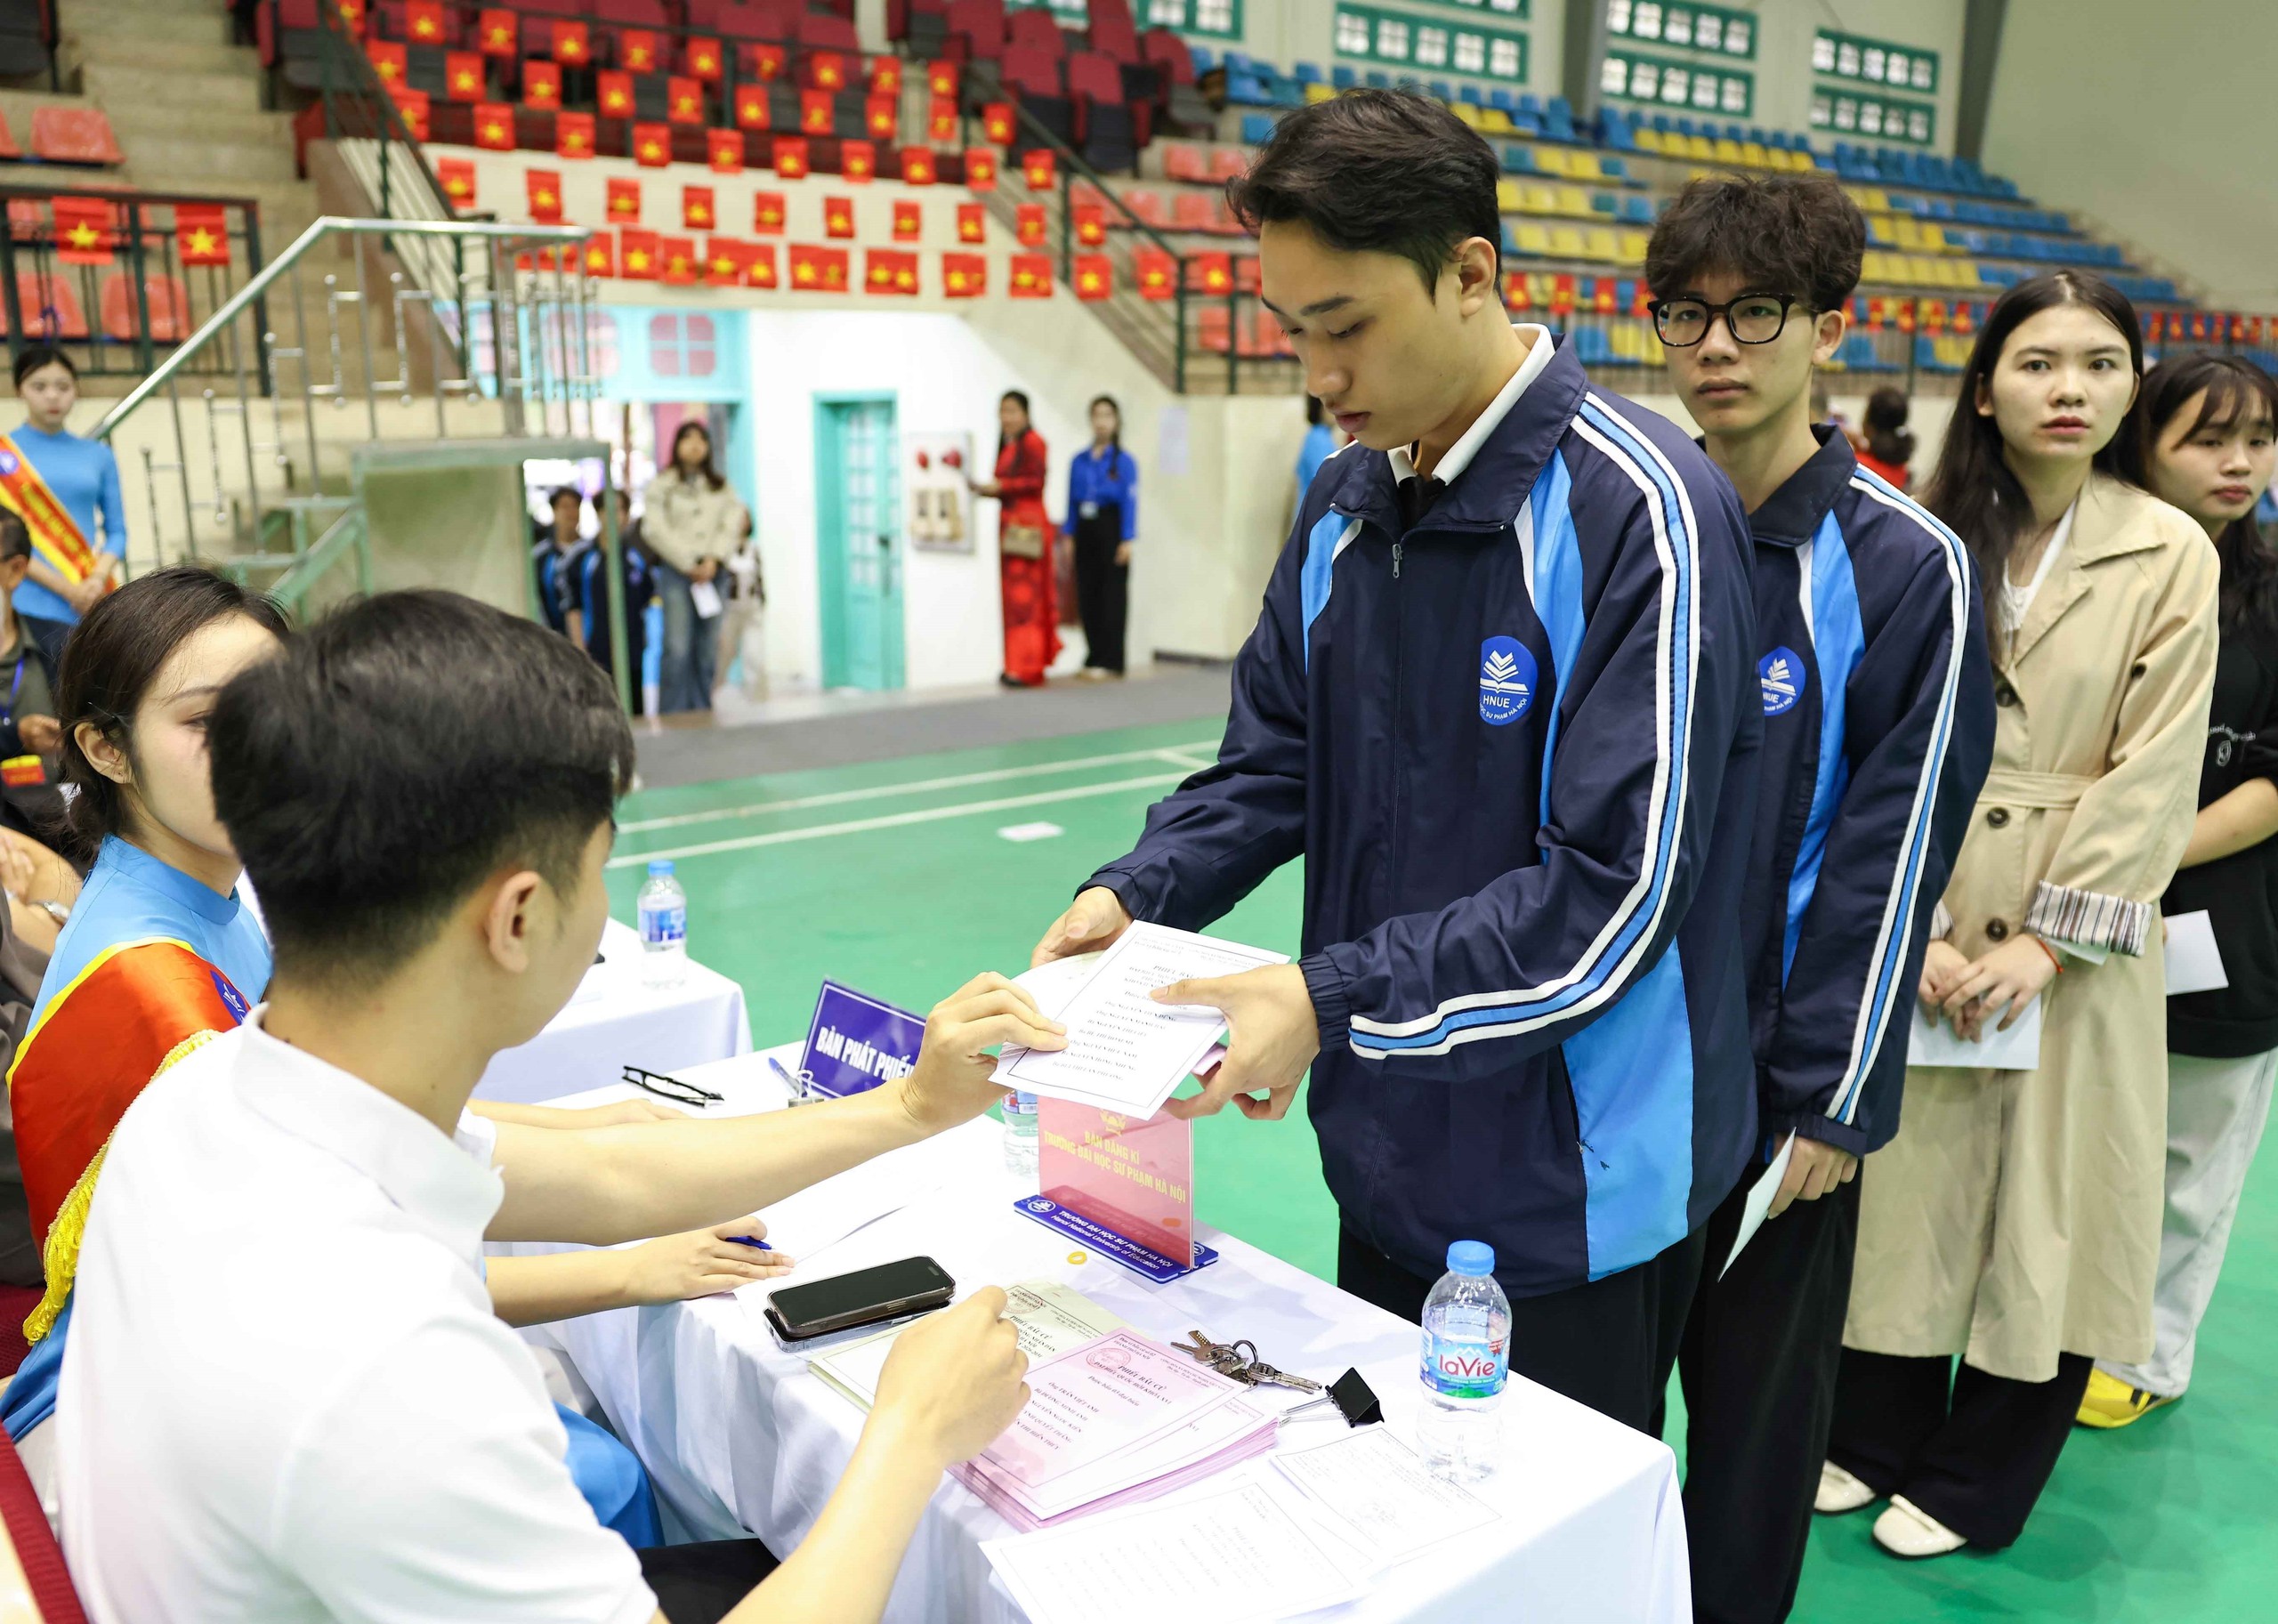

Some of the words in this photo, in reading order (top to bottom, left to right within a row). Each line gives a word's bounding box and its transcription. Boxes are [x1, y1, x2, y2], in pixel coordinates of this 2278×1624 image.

[1482, 695, 1511, 708] HNUE
[841, 1040, 878, 1074] PHÁT
[1078, 1144, 1092, 1163] ĐẠI
[1095, 1152, 1111, 1171] HỌC
[1112, 1159, 1127, 1176] SƯ
[1127, 1166, 1153, 1189] PHẠM
[1155, 1177, 1167, 1196] HÀ
[1169, 1184, 1186, 1203] NỘI
[1050, 1215, 1071, 1226] Hanoi
[1067, 1222, 1095, 1238] National
[1092, 1234, 1123, 1252] University
[1127, 1253, 1160, 1270] Education
[1059, 1210, 1089, 1227] TRƯỜNG
[1099, 1230, 1117, 1240] HỌC
[1125, 1243, 1149, 1256] PHẠM
[1010, 1315, 1028, 1327] PHIẾU
[1027, 1325, 1040, 1334] BẦU
[1119, 1365, 1139, 1378] PHIẾU
[1138, 1376, 1153, 1386] BẦU
[1439, 1353, 1496, 1378] laVie
